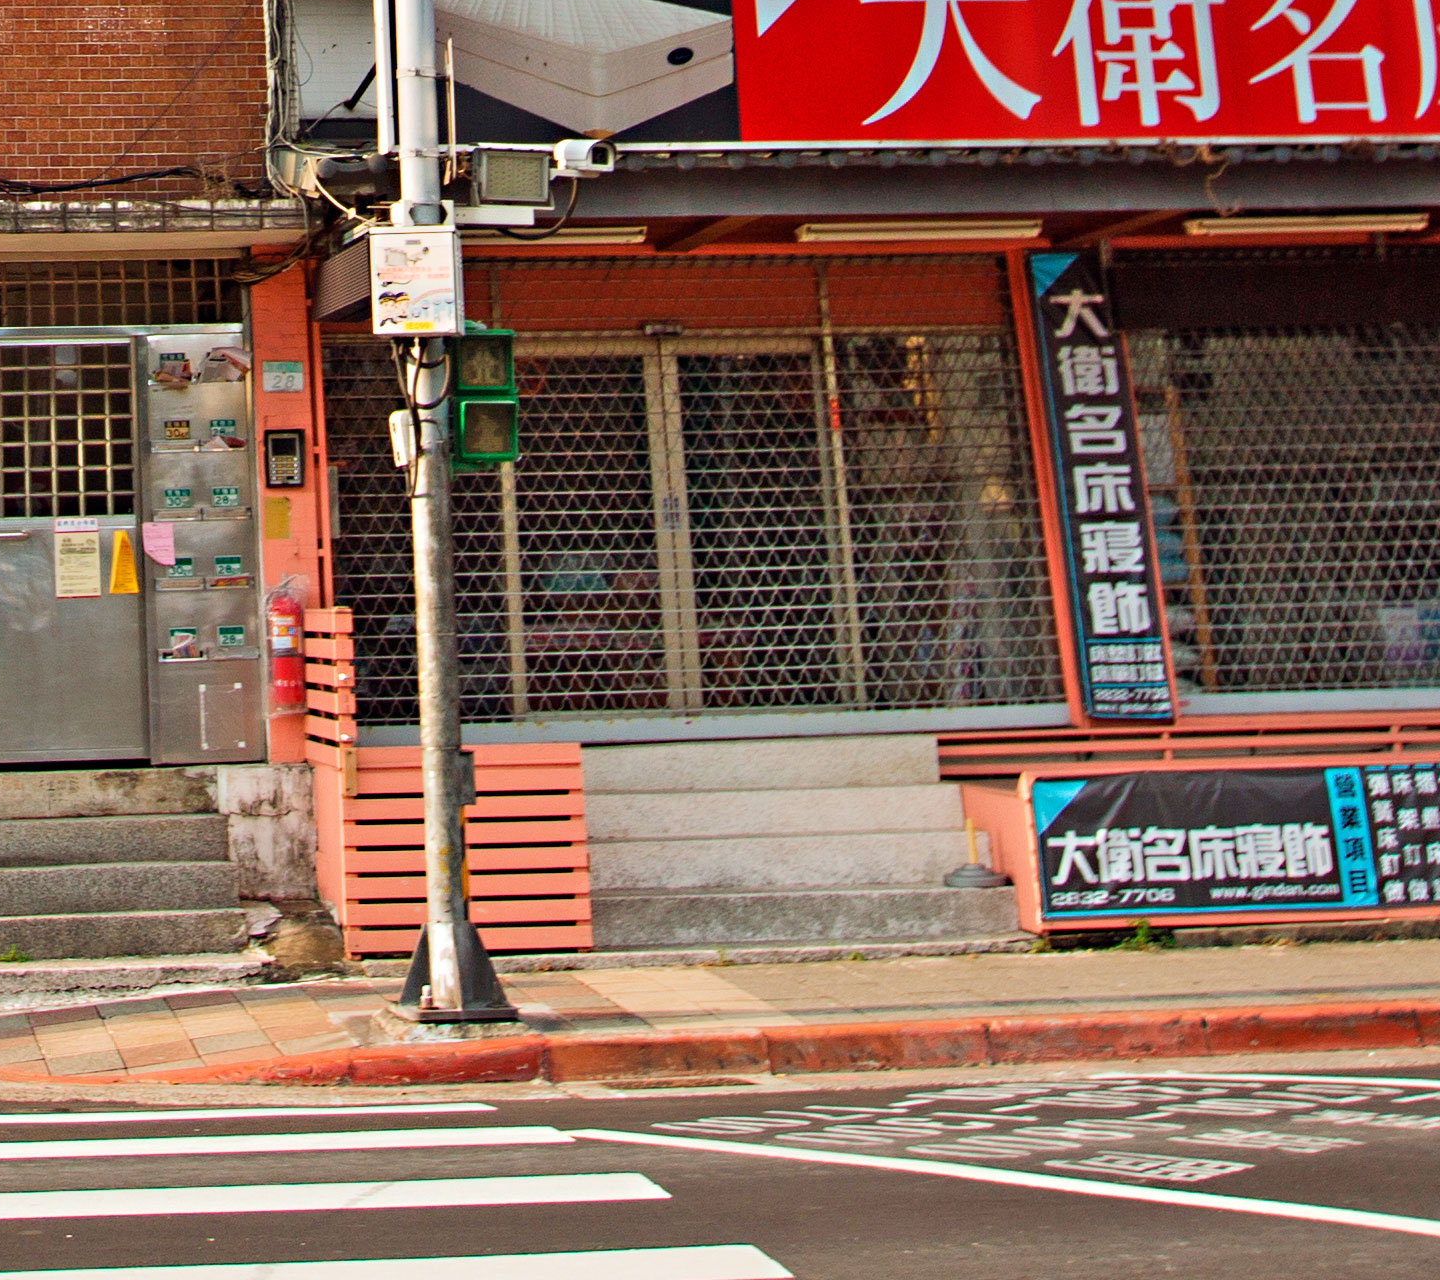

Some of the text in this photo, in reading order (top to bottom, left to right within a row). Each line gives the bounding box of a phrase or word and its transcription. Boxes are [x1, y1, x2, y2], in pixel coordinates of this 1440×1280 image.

[272, 375, 295, 389] 28
[1049, 289, 1151, 636] 大衛名床寢飾
[1046, 821, 1336, 885] 大衛名床寢飾
